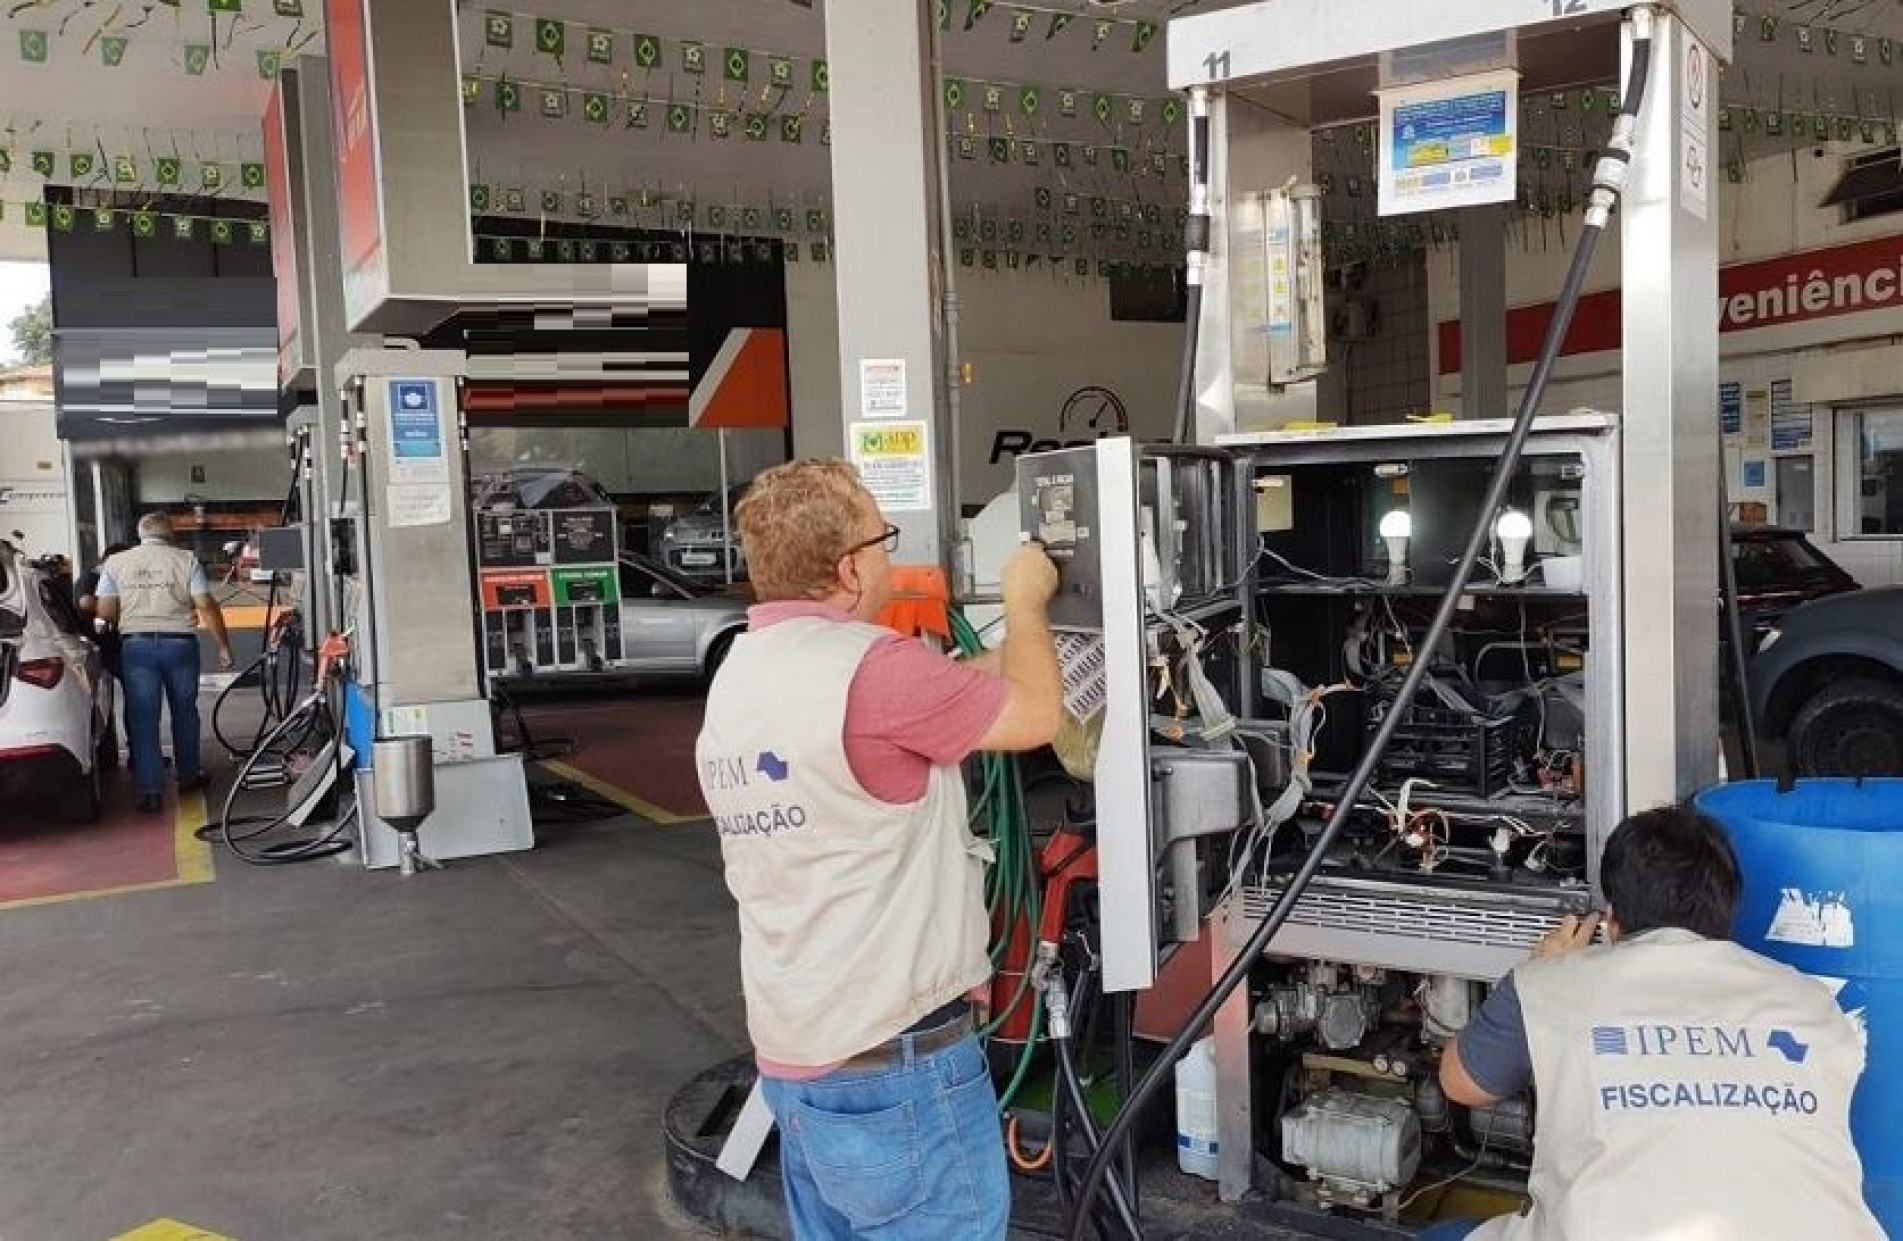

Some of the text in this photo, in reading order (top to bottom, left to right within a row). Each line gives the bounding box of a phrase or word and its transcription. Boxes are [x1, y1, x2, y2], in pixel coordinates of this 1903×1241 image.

[1202, 50, 1231, 80] 11
[1636, 1025, 1756, 1058] IPEM
[1600, 1082, 1818, 1115] FISCALIZAÇÃO
